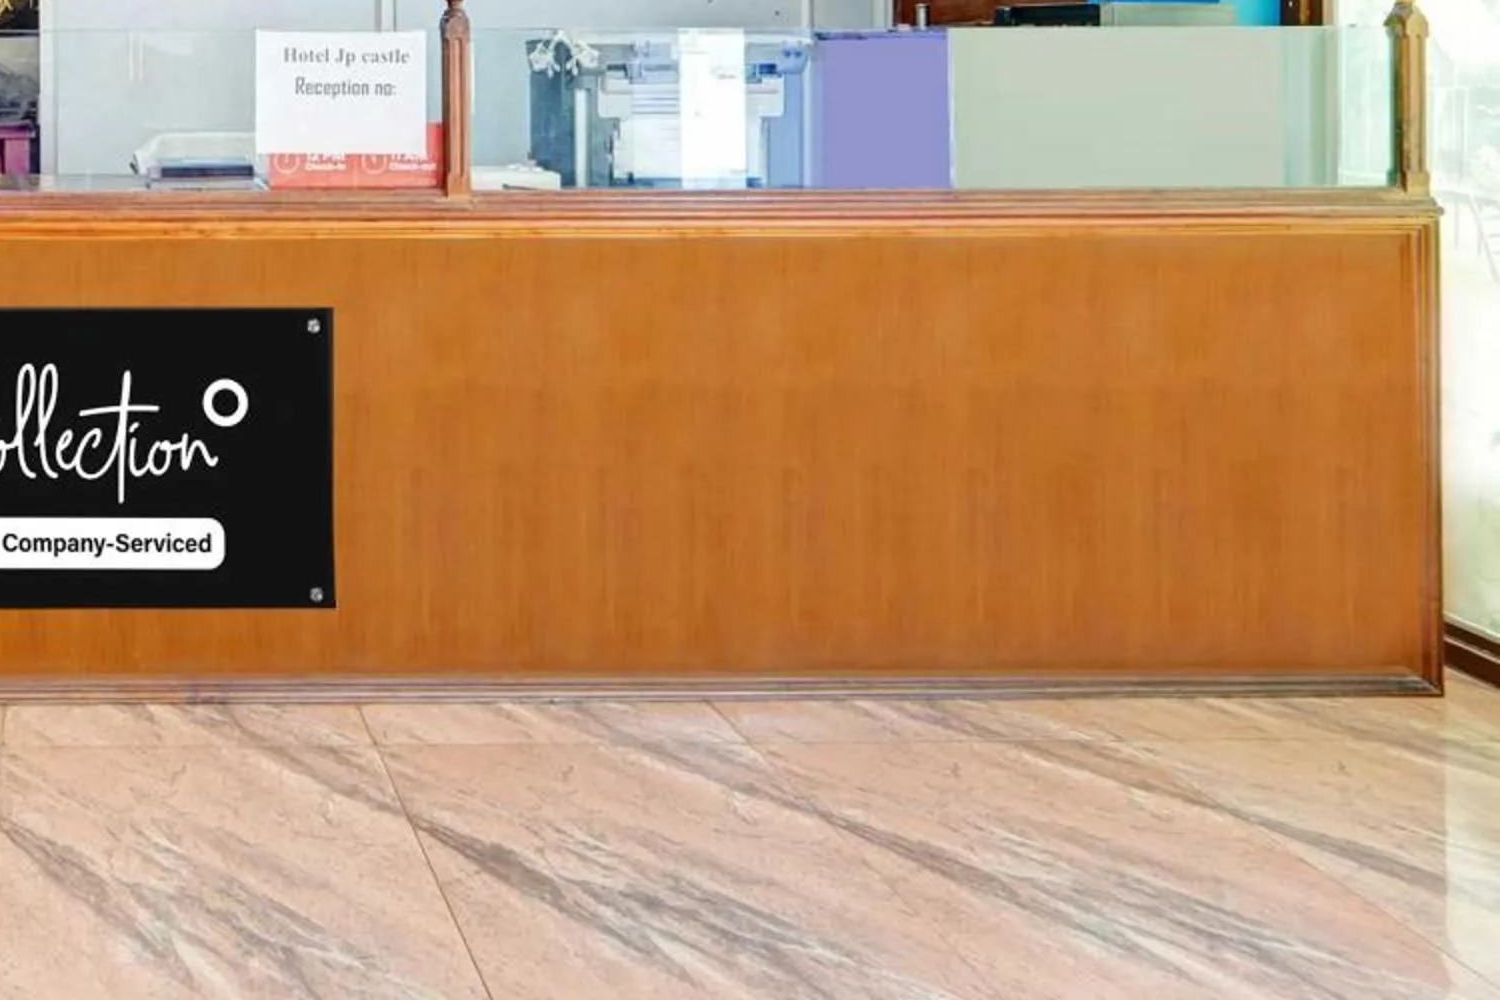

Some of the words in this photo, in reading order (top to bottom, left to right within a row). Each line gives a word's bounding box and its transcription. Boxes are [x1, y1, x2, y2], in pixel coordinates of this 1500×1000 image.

[283, 47, 329, 63] Hotel
[335, 48, 356, 67] Jp
[361, 49, 411, 65] castle
[294, 76, 369, 98] Reception
[2, 532, 213, 558] Company-Serviced
